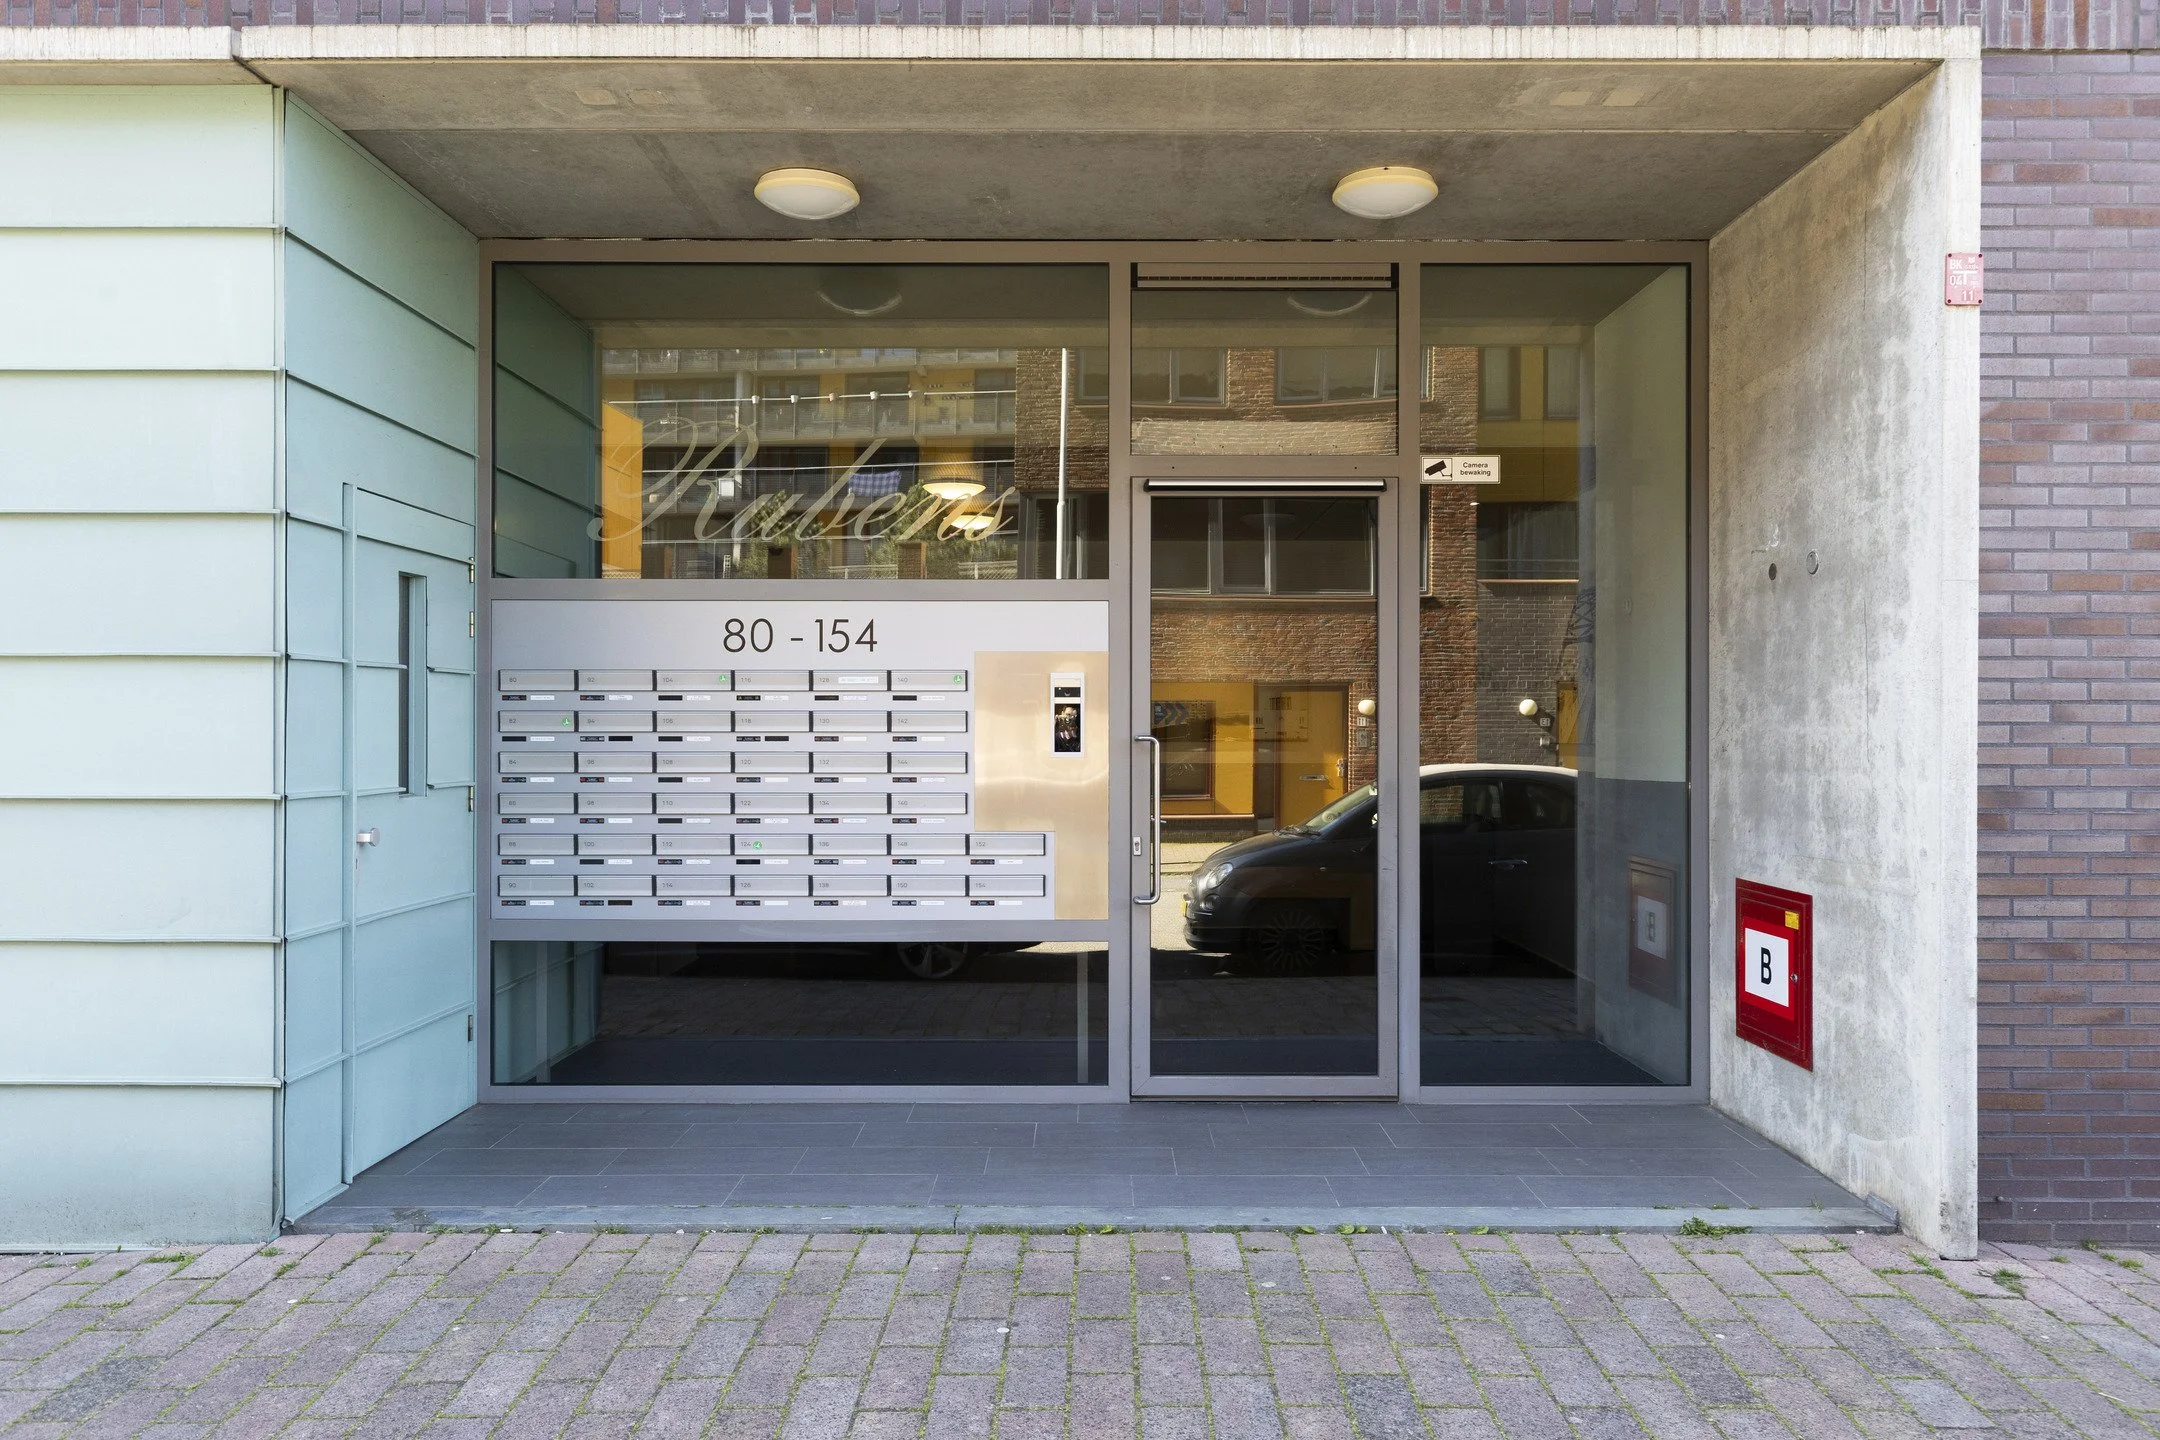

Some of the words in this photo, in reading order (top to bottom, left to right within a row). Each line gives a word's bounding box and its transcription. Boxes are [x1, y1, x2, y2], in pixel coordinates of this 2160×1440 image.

[1949, 258, 1963, 270] BK
[1459, 469, 1492, 477] bewaking
[1462, 461, 1489, 469] Camera
[585, 416, 1017, 542] Rubens
[723, 618, 774, 653] 80
[1760, 946, 1773, 985] B
